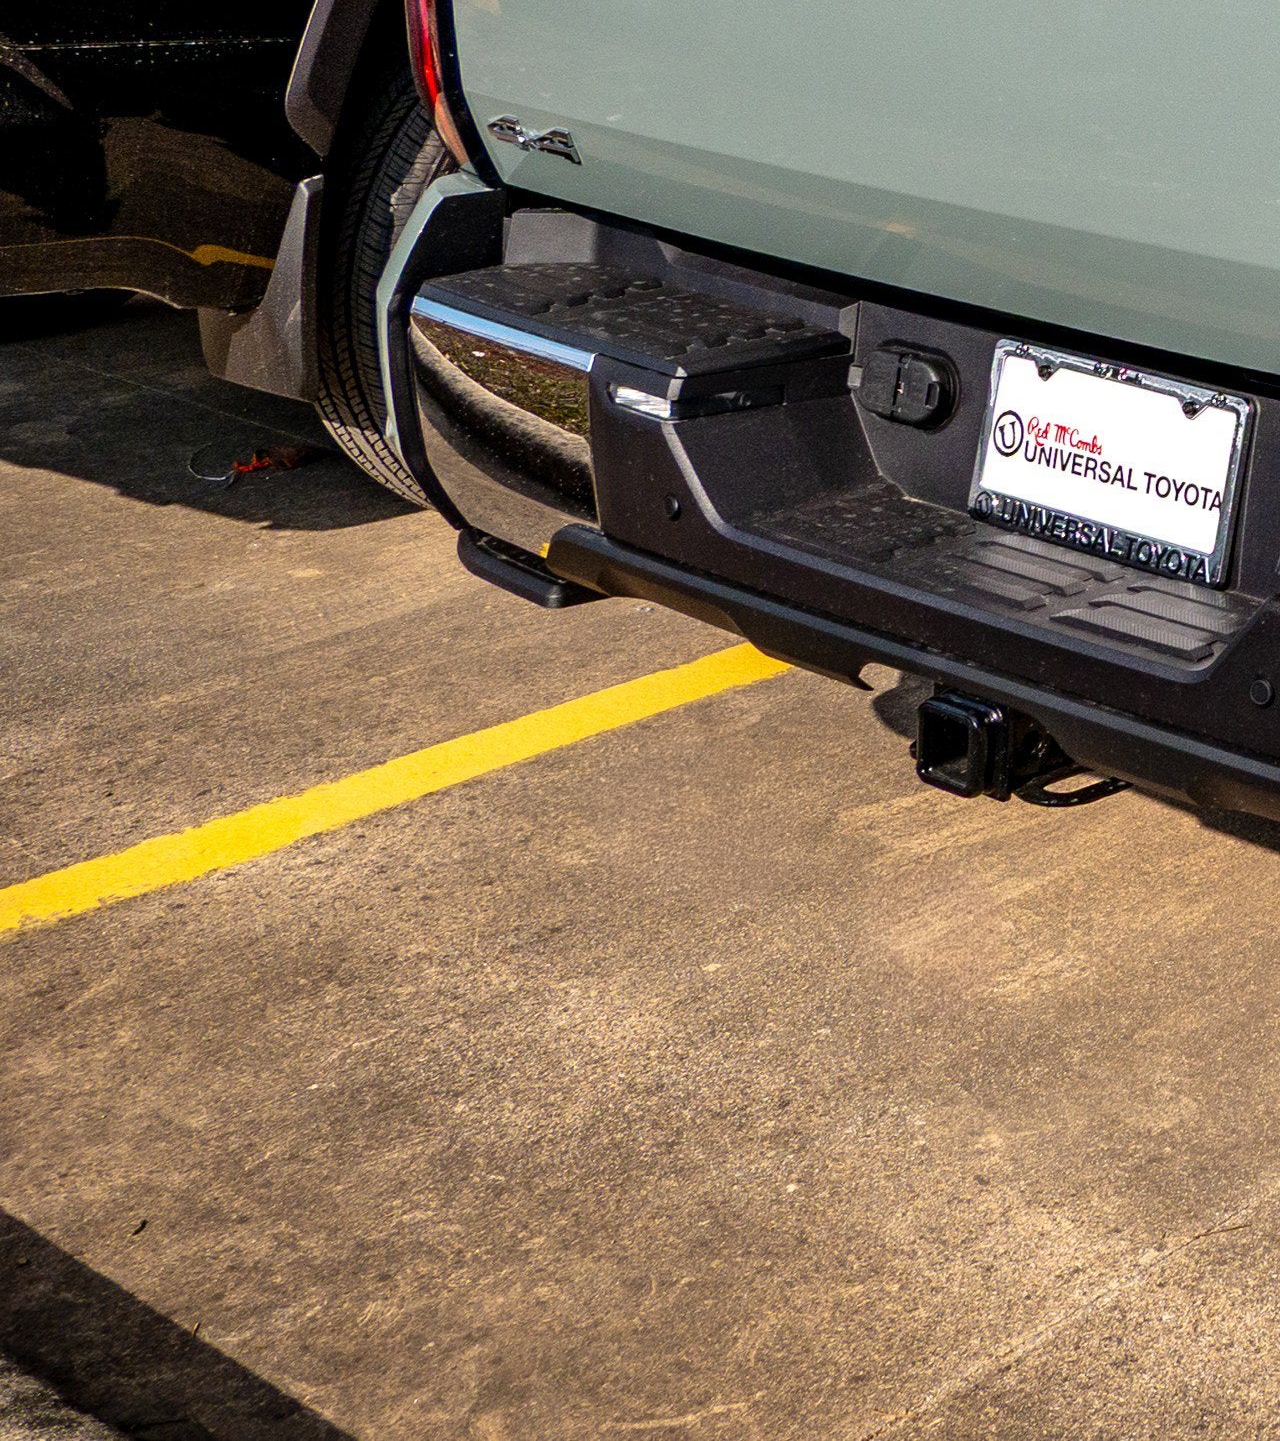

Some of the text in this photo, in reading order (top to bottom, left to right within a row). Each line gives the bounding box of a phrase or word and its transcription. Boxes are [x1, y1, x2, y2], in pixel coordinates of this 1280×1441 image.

[1027, 416, 1103, 456] Red McCombs
[1024, 440, 1223, 512] UNIVERSAL TOYOTA
[1001, 496, 1124, 556] UNIVERSAL
[1125, 535, 1212, 584] TOYOTA
